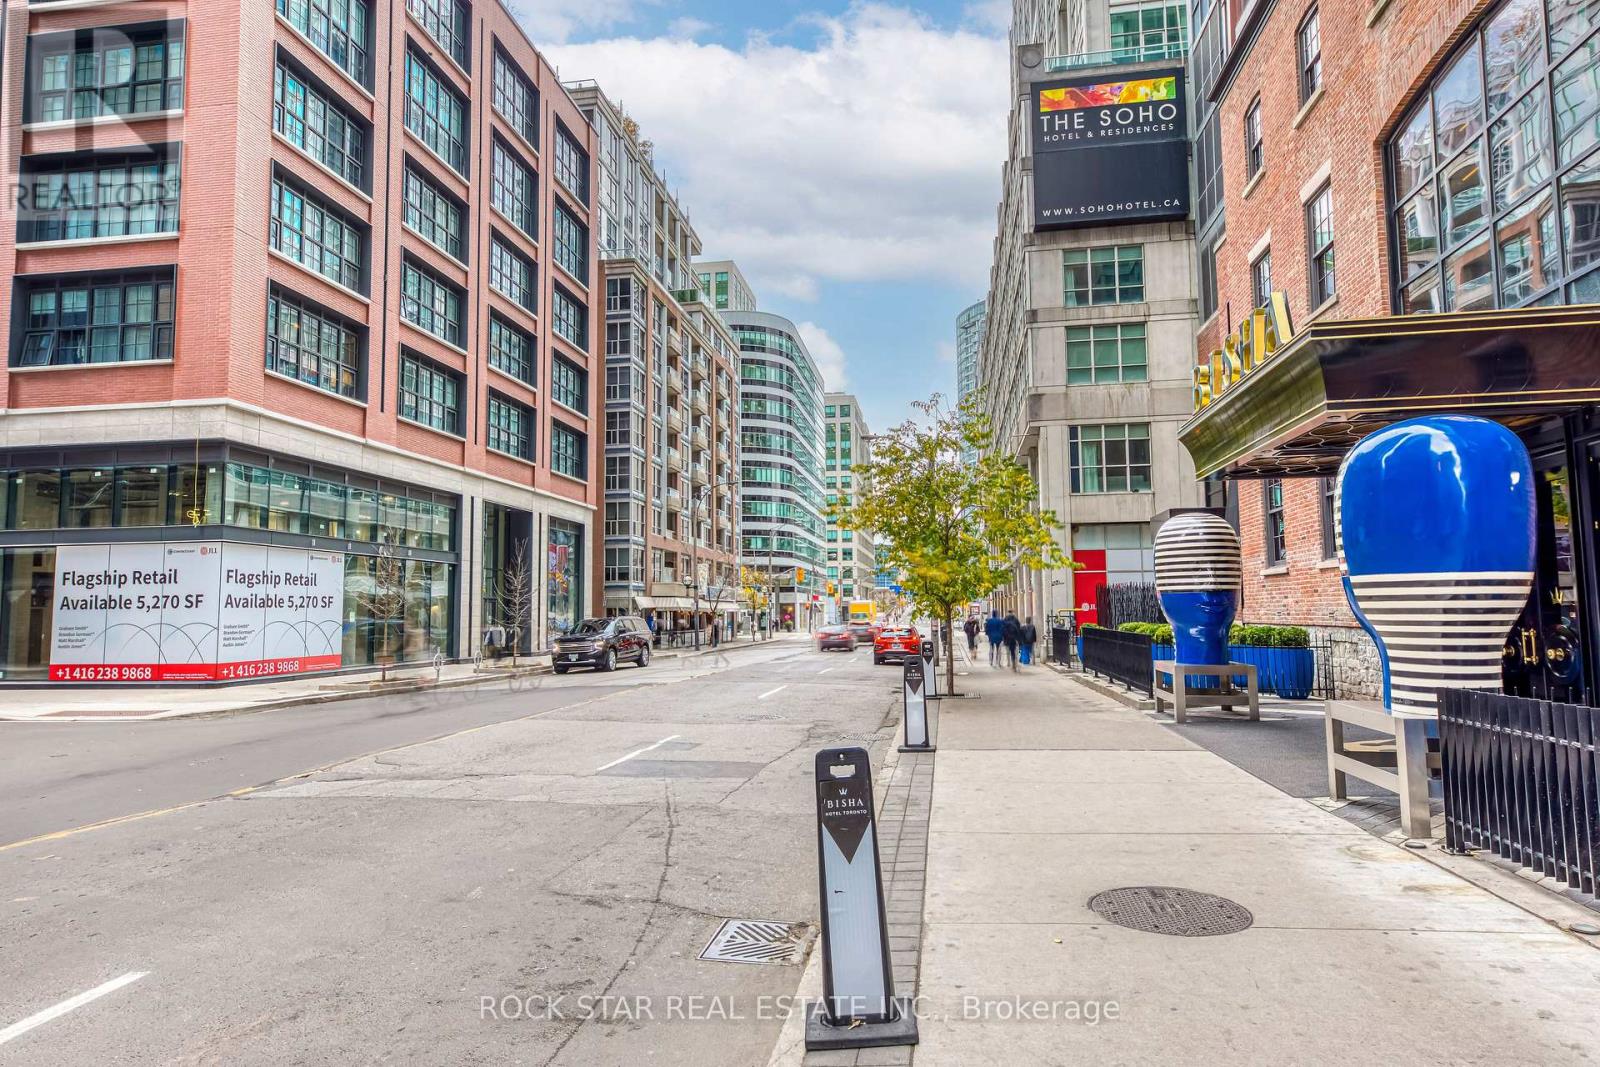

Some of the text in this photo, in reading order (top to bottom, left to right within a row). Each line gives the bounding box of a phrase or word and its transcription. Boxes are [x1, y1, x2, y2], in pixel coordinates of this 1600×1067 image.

[1040, 103, 1177, 132] THE SOHO
[1044, 132, 1081, 143] HOTEL
[1100, 123, 1174, 137] RESIDENCES
[1042, 199, 1181, 217] WWW.SOHOHOTEL.CA
[1192, 289, 1296, 412] BISHA
[62, 569, 178, 590] Flagship Retail
[226, 569, 317, 588] Flagship Retail
[60, 594, 204, 612] Available 5,270 SF
[224, 593, 333, 611] Available 5,270 SF
[56, 667, 152, 679] +1 416 238 9868
[222, 666, 235, 678] +1
[237, 664, 256, 676] 416
[257, 662, 275, 675] 238
[277, 660, 299, 673] 9868
[827, 798, 864, 809] BISHA
